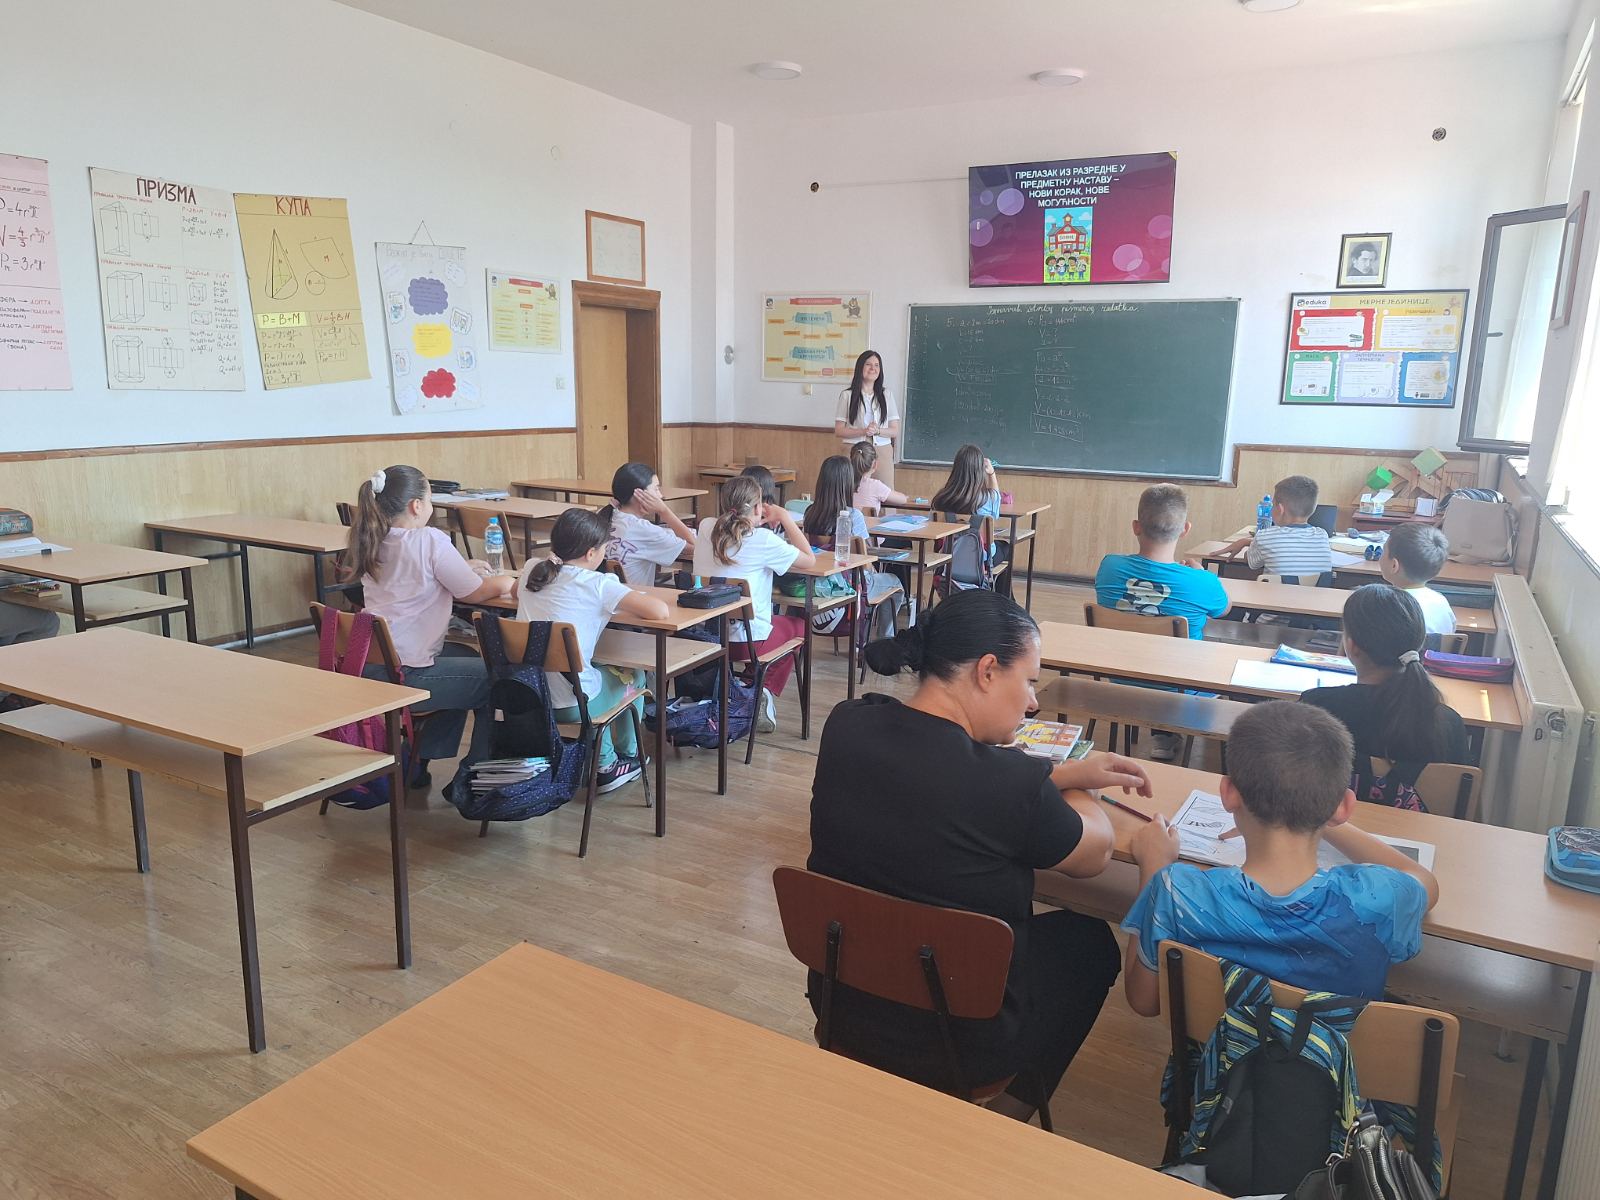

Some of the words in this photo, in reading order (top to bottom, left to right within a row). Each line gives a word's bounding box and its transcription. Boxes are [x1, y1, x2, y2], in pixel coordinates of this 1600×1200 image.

[1015, 169, 1058, 180] ПРЕЛАЗАК
[1059, 168, 1071, 177] ИЗ
[1072, 165, 1118, 176] РАЗРЕДНЕ
[1119, 164, 1127, 173] У
[1020, 178, 1072, 190] ПРЕДМЕТНУ
[1073, 175, 1113, 186] НАСТАВУ
[136, 177, 197, 206] ПРИЗМА
[1028, 189, 1053, 198] НОВИ
[1085, 185, 1110, 195] НОВЕ
[275, 197, 312, 217] КУПА
[1037, 196, 1098, 208] МОГУЋНОСТИ
